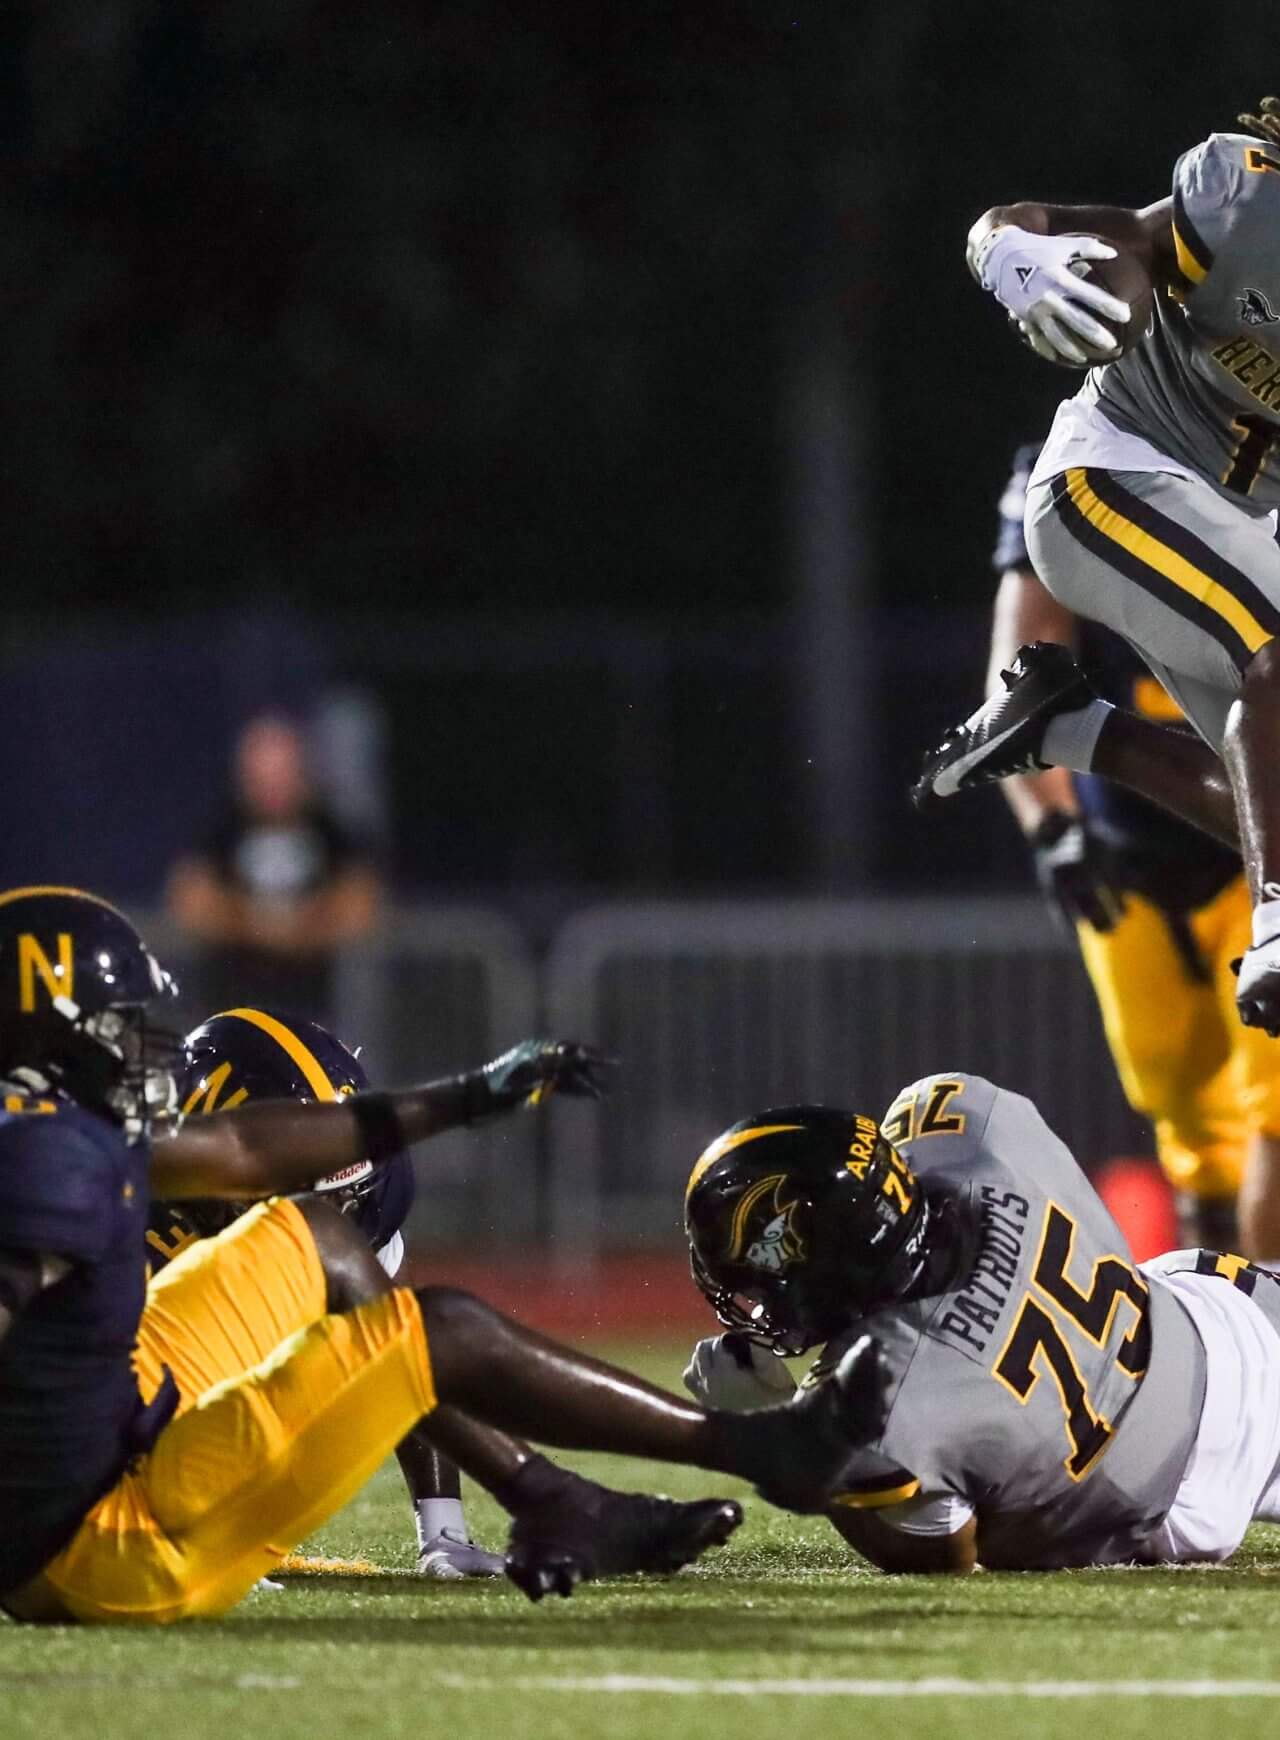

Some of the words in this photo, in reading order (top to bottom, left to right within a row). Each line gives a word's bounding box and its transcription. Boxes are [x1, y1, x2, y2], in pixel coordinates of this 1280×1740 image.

[18, 933, 74, 1013] N
[940, 1185, 1030, 1353] PATRIOTS
[991, 1199, 1152, 1482] 75
